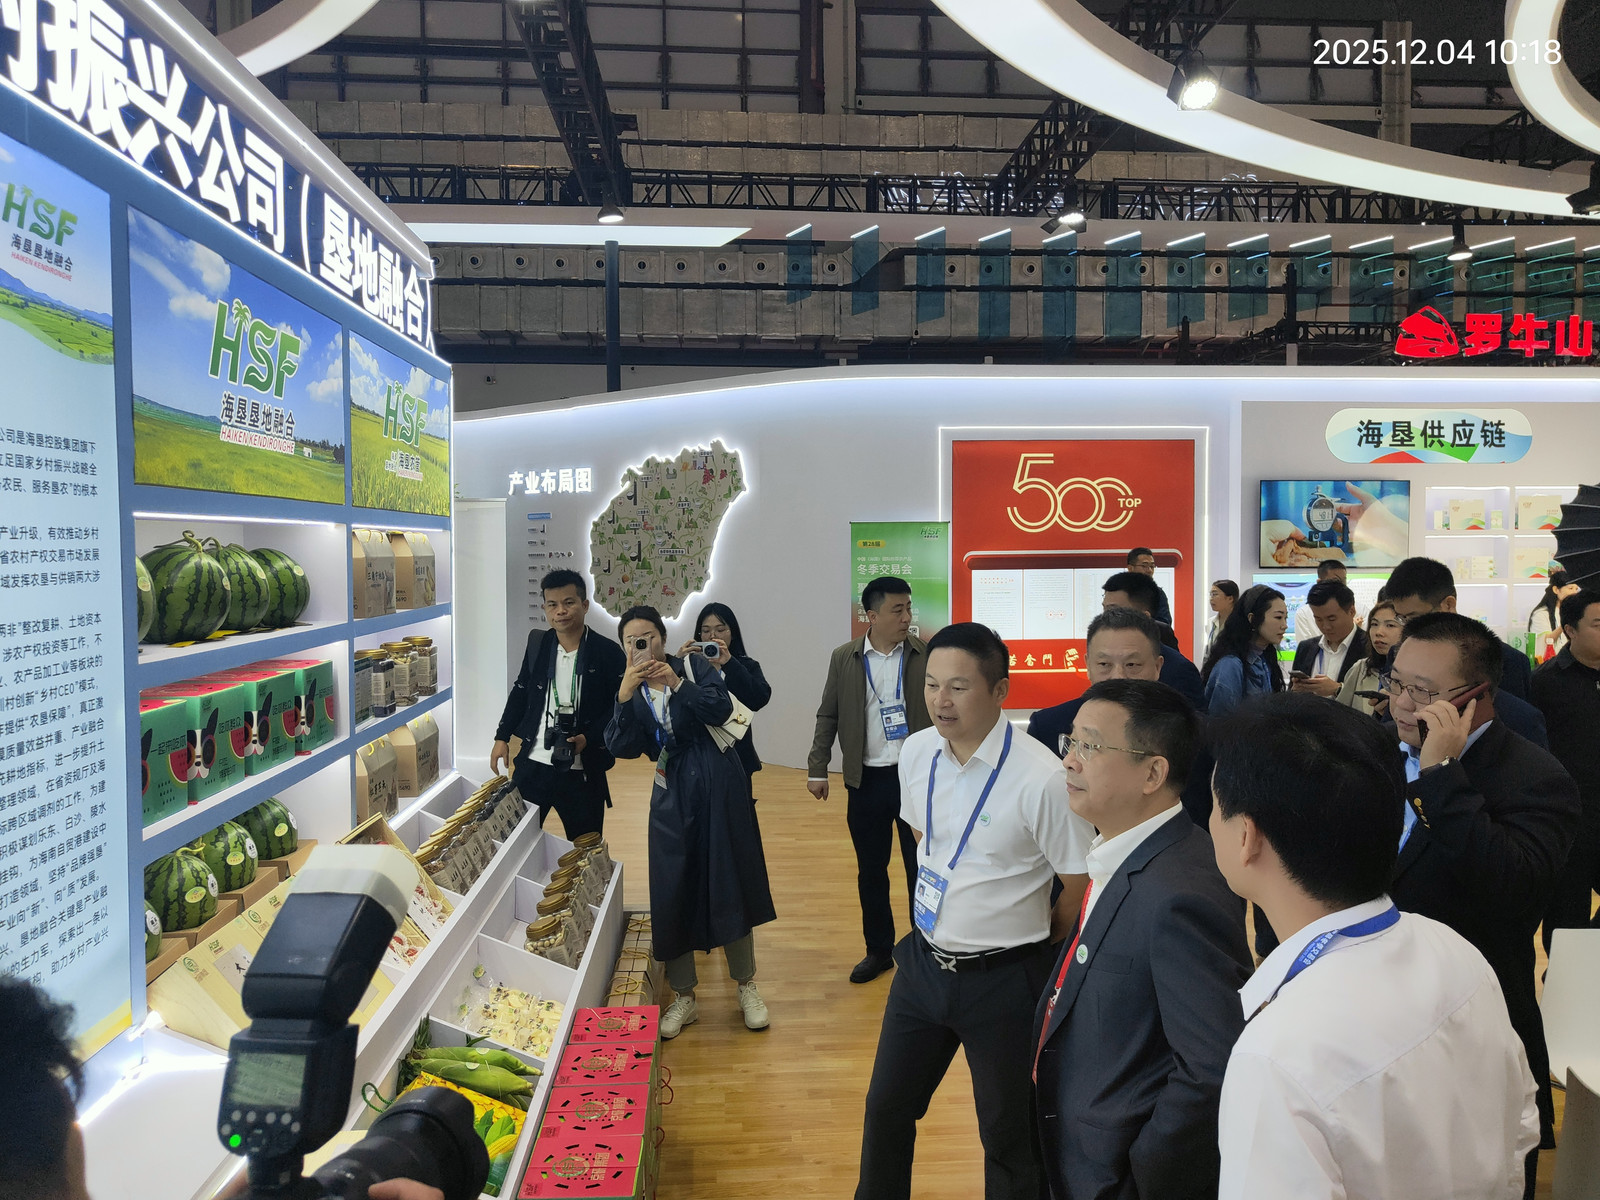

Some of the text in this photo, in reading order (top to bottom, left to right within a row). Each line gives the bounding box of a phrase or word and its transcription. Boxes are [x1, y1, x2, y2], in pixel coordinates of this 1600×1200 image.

[2, 182, 78, 246] HSF
[11, 233, 73, 272] 海垦垦地融合
[208, 298, 301, 400] HSF
[1464, 312, 1593, 357] 罗牛山
[221, 393, 295, 438] 海垦垦地融合
[383, 381, 428, 447] HSF
[221, 427, 295, 454] HAIKEN KENDIRONGHE
[1357, 420, 1506, 448] 海垦供应链
[0, 477, 98, 497] 农民、服务垦农”的根本
[508, 467, 592, 495] 产业布局图
[1006, 453, 1142, 533] 500 TOP
[0, 548, 100, 565] 省农村产权交易市场发展
[857, 563, 912, 575] 冬季交易会
[0, 655, 103, 688] 、农产品加工业等板块的
[24, 926, 109, 986] 构，助力乡村产业兴
